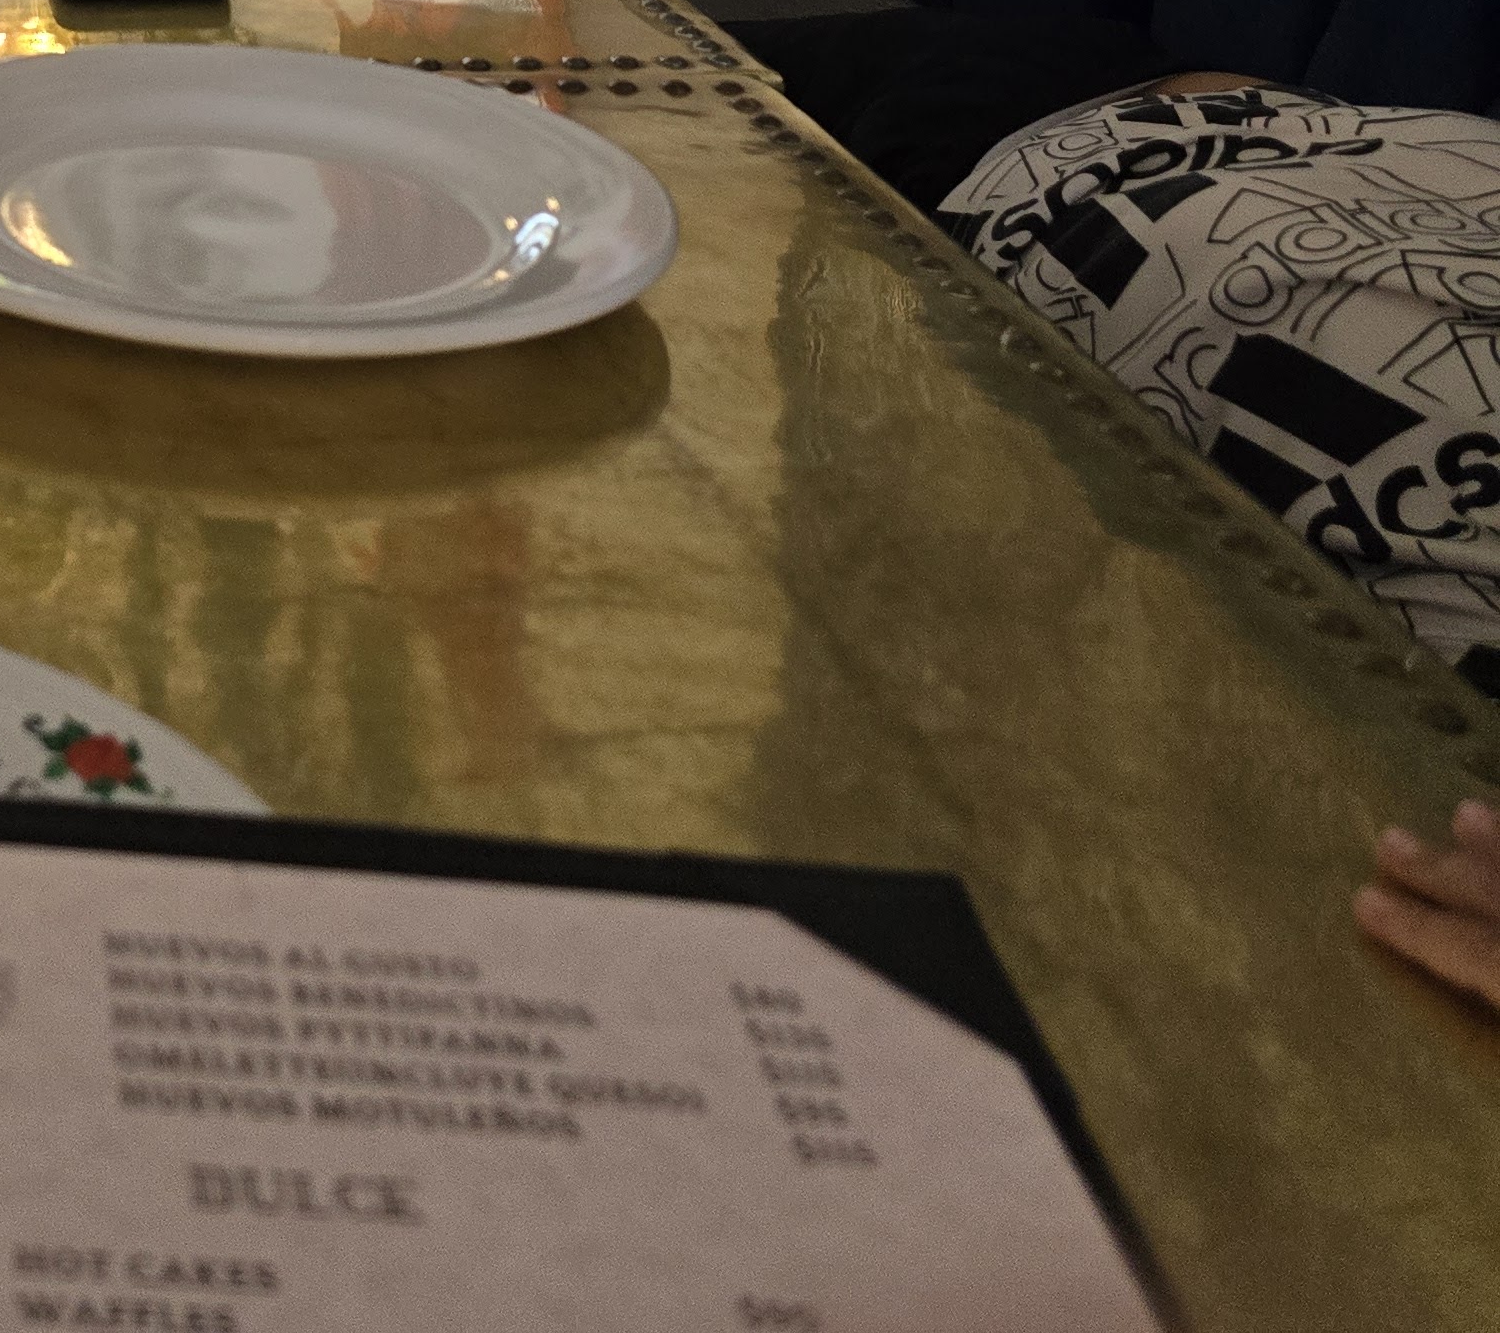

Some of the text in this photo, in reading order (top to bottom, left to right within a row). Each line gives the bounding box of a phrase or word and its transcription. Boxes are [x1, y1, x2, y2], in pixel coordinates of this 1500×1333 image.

[105, 931, 269, 968] HUEVOS
[342, 948, 480, 983] GUSTO
[107, 967, 277, 1006] HUEVOS
[111, 1003, 282, 1043] HUEVOS
[117, 1081, 297, 1122] HUEVOS
[190, 1159, 426, 1226] DULCE
[12, 1241, 283, 1295] HOT CAKES
